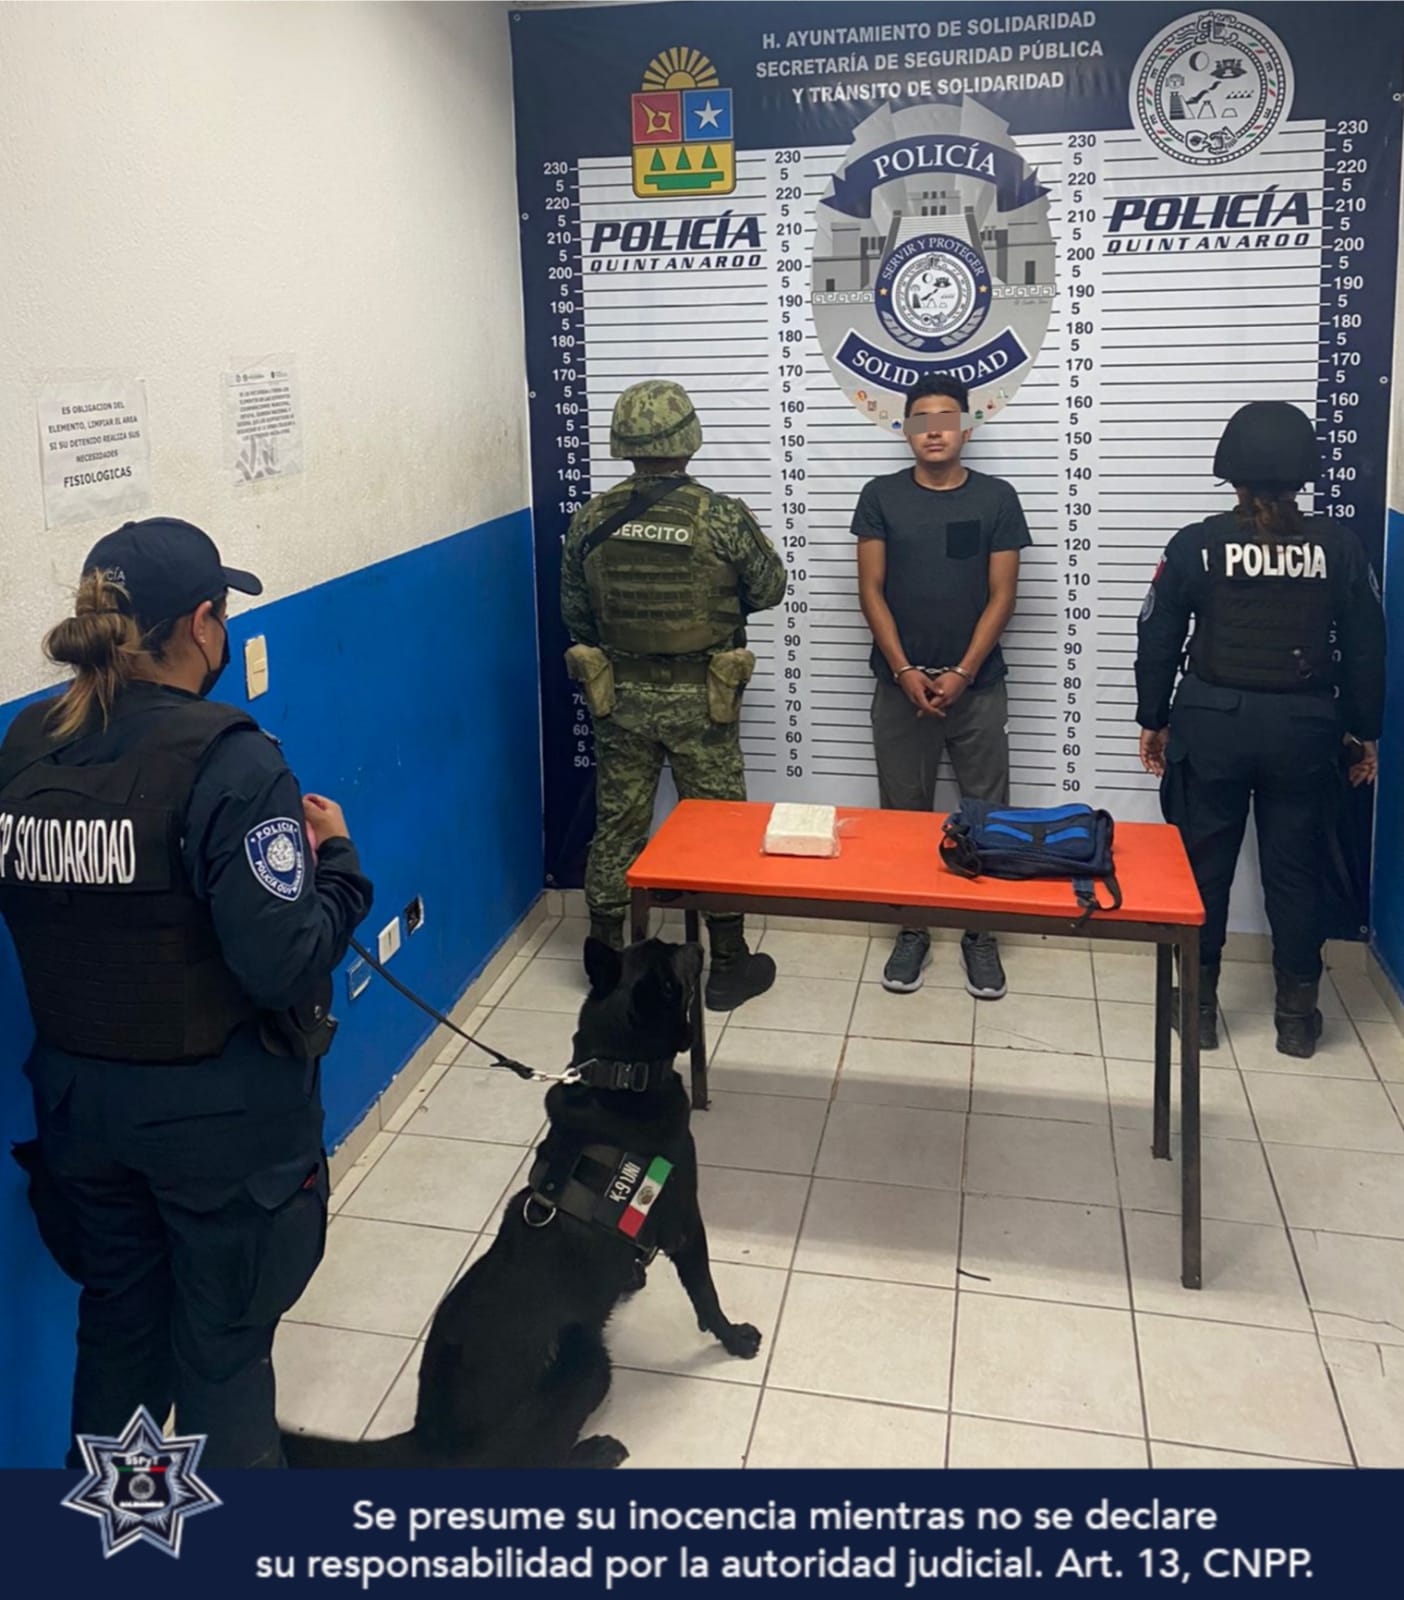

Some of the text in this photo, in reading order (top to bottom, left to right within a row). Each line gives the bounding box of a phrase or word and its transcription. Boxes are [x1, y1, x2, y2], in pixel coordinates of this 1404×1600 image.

[763, 11, 1096, 49] H. AYUNTAMIENTO DE SOLIDARIDAD
[756, 40, 1103, 78] SECRETARÍA DE SEGURIDAD PÚBLICA
[792, 71, 1064, 104] Y TRÁNSITO DE SOLIDARIDAD
[1337, 120, 1368, 135] 230
[1068, 134, 1097, 148] 230
[1342, 138, 1353, 153] 5
[775, 150, 801, 164] 230
[872, 142, 996, 180] POLICÍA
[543, 161, 568, 175] 230
[1336, 158, 1367, 174] 220
[1067, 171, 1096, 186] 220
[556, 179, 564, 192] 5
[775, 186, 802, 200] 220
[545, 196, 570, 210] 220
[1107, 184, 1310, 232] POLICÍA
[1335, 197, 1366, 212] 210
[781, 204, 790, 217] 5
[1067, 209, 1096, 223] 210
[776, 222, 802, 236] 210
[1340, 216, 1351, 231] 5
[590, 209, 761, 253] POLICÍA
[1072, 227, 1082, 241] 5
[547, 231, 572, 245] 210
[1333, 237, 1365, 252] 200
[559, 249, 568, 262] 5
[881, 237, 986, 280] SERVIR Y PROTEGER
[1066, 247, 1095, 261] 200
[776, 258, 803, 272] 200
[548, 266, 573, 280] 200
[1333, 275, 1364, 290] 190
[1067, 284, 1095, 298] 190
[550, 301, 574, 314] 190
[777, 294, 803, 308] 190
[1337, 294, 1348, 308] 5
[1071, 302, 1081, 315] 5
[781, 311, 791, 324] 5
[1332, 314, 1362, 328] 180
[1066, 321, 1094, 335] 180
[551, 335, 575, 348] 180
[778, 329, 803, 343] 180
[563, 352, 571, 364] 5
[1065, 358, 1094, 371] 170
[1331, 352, 1361, 366] 170
[552, 368, 576, 381] 170
[778, 364, 803, 377] 170
[1335, 370, 1346, 384] 5
[782, 380, 791, 394] 5
[1070, 375, 1080, 388] 5
[1065, 395, 1093, 409] 160
[1329, 392, 1359, 406] 160
[61, 406, 71, 415] ES
[554, 402, 578, 415] 160
[779, 400, 805, 413] 160
[566, 419, 575, 432] 5
[556, 436, 579, 448] 150
[780, 434, 805, 447] 150
[1065, 431, 1092, 445] 150
[1328, 430, 1358, 444] 150
[784, 450, 793, 463] 5
[1069, 448, 1079, 461] 5
[63, 466, 132, 488] FISIOLOGICAS
[557, 468, 579, 481] 140
[781, 468, 806, 481] 140
[1064, 467, 1092, 480] 140
[1327, 467, 1356, 481] 140
[568, 485, 577, 497] 5
[1330, 484, 1341, 498] 5
[781, 502, 806, 515] 130
[1064, 502, 1092, 516] 130
[1326, 504, 1355, 518] 130
[782, 536, 806, 548] 120
[1064, 538, 1091, 551] 120
[786, 551, 795, 563] 5
[1068, 554, 1078, 567] 5
[1063, 573, 1090, 586] 110
[784, 601, 808, 614] 100
[1064, 607, 1090, 620] 100
[787, 617, 796, 629] 5
[1067, 624, 1077, 636] 5
[784, 634, 801, 647] 90
[1063, 642, 1082, 655] 90
[784, 667, 801, 680] 80
[788, 682, 797, 694] 5
[1063, 676, 1082, 690] 80
[1067, 692, 1076, 705] 5
[784, 699, 802, 712] 70
[1063, 710, 1081, 724] 70
[573, 724, 589, 736] 60
[785, 731, 802, 744] 60
[577, 740, 586, 752] 5
[1062, 743, 1081, 756] 60
[789, 748, 798, 760] 5
[574, 756, 590, 768] 50
[786, 765, 803, 778] 50
[1062, 779, 1081, 792] 50
[14, 815, 136, 884] SOLIDARIDAD
